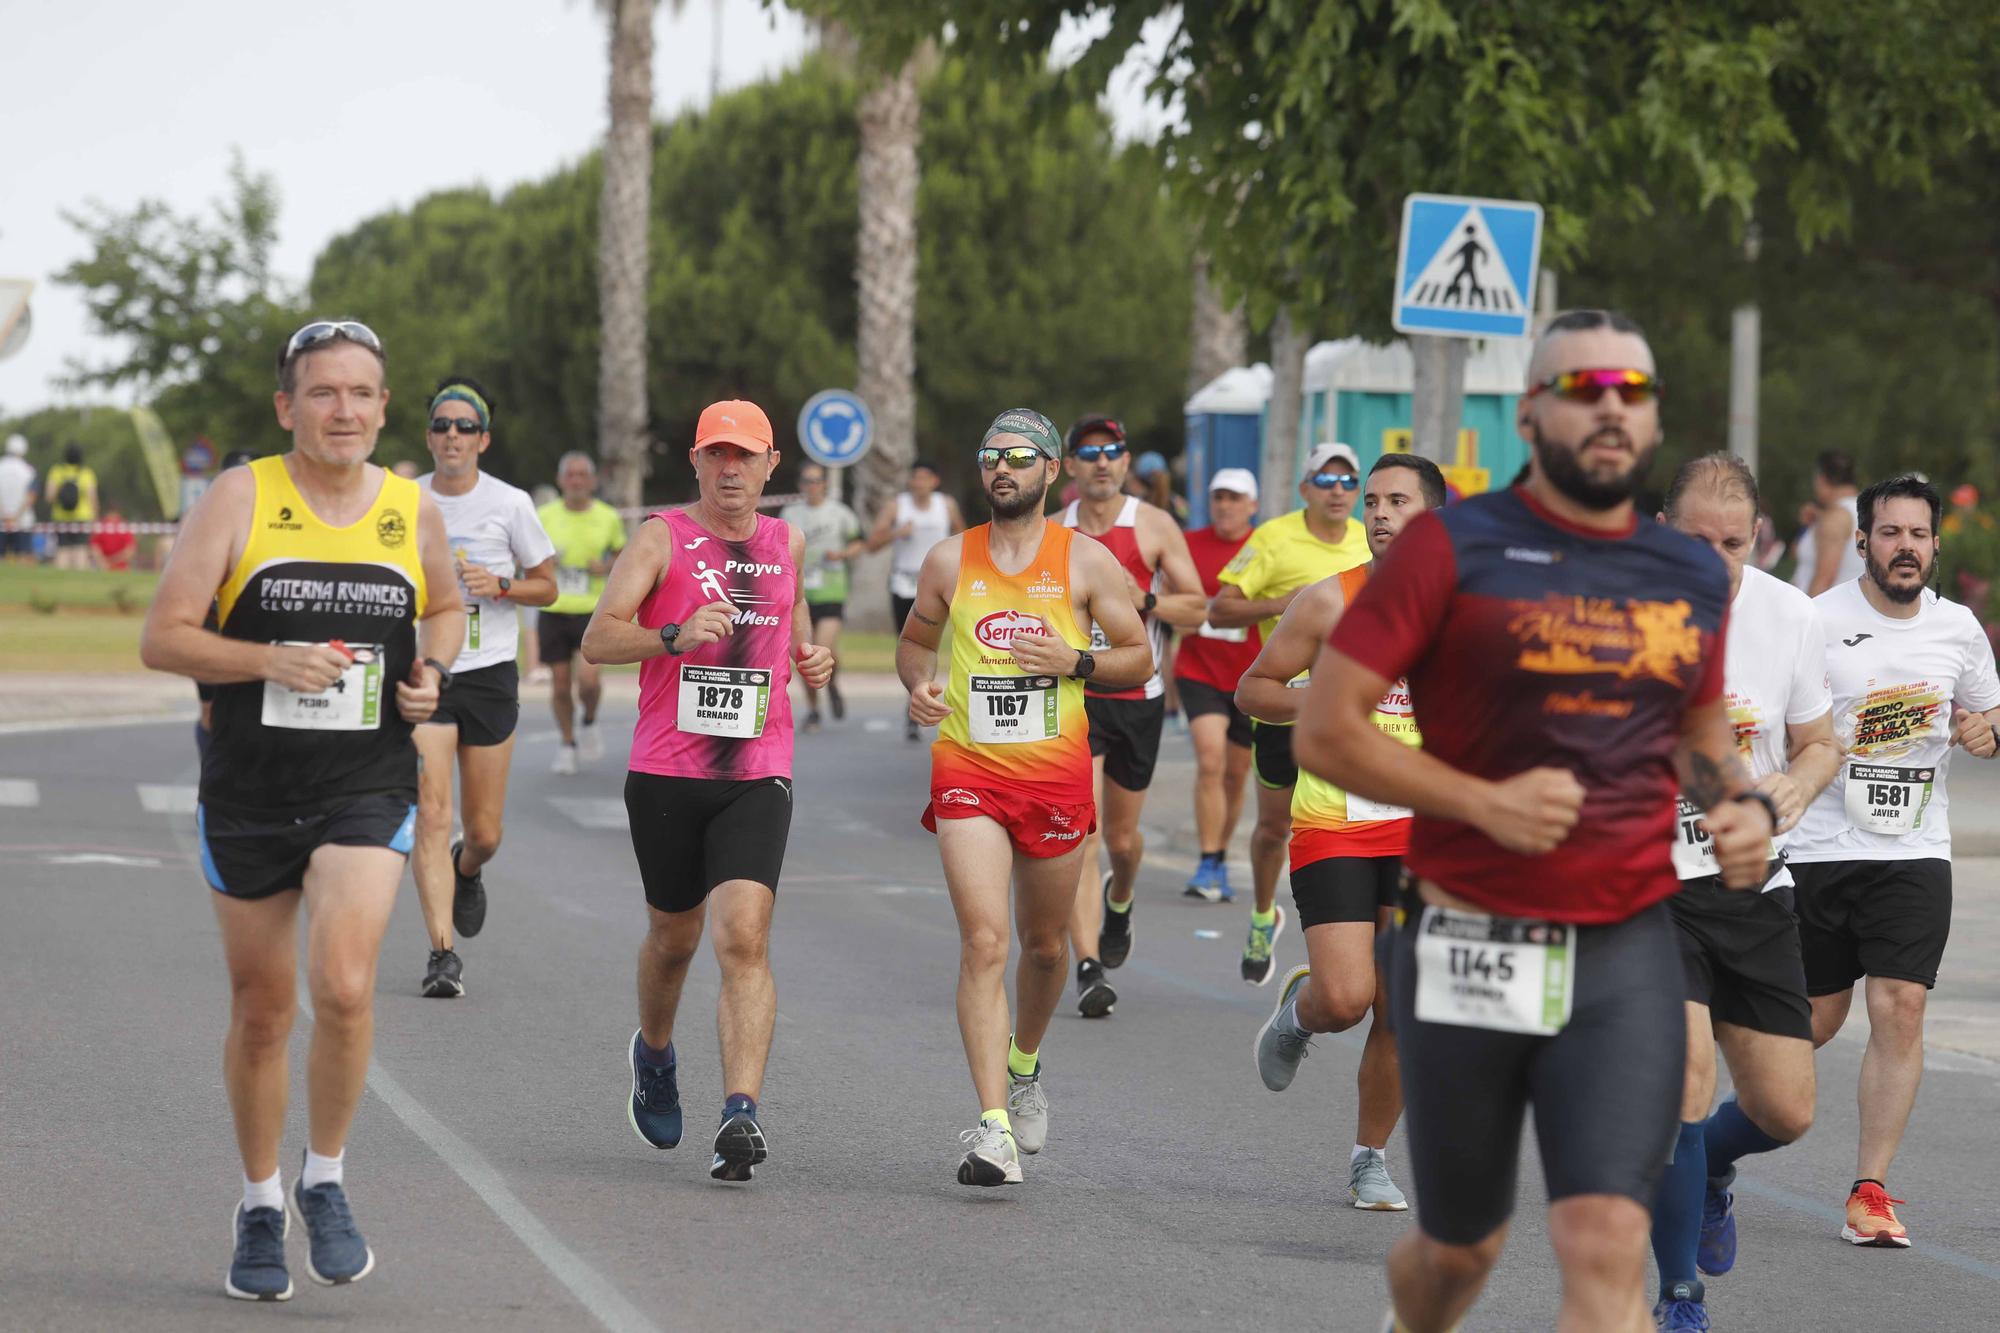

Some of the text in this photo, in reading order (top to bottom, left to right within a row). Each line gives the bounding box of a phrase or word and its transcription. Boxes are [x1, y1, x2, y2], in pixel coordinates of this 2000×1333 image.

[725, 560, 782, 577] Proyve
[261, 578, 408, 605] PATERNA RUNNERS
[1026, 586, 1064, 594] SERRANO
[261, 600, 406, 618] CLUB ATLETISMO
[978, 655, 1017, 665] Alimento
[698, 686, 743, 709] 1878
[987, 695, 1028, 716] 1167
[1047, 696, 1055, 710] BOX
[1380, 693, 1412, 706] erra
[697, 710, 738, 720] BERNARDO
[1862, 705, 1927, 727] MARATÓN
[1865, 701, 1904, 717] MEDIO
[995, 719, 1018, 727] DAVID
[1384, 723, 1400, 733] BIEN
[1402, 724, 1407, 733] Y
[1409, 723, 1422, 733] CO
[1881, 719, 1907, 731] VILA
[1910, 717, 1926, 726] DE
[1858, 728, 1910, 745] PATERNA
[1867, 784, 1910, 807] 1581
[1871, 808, 1900, 818] JAVIER
[1450, 947, 1515, 981] 1145
